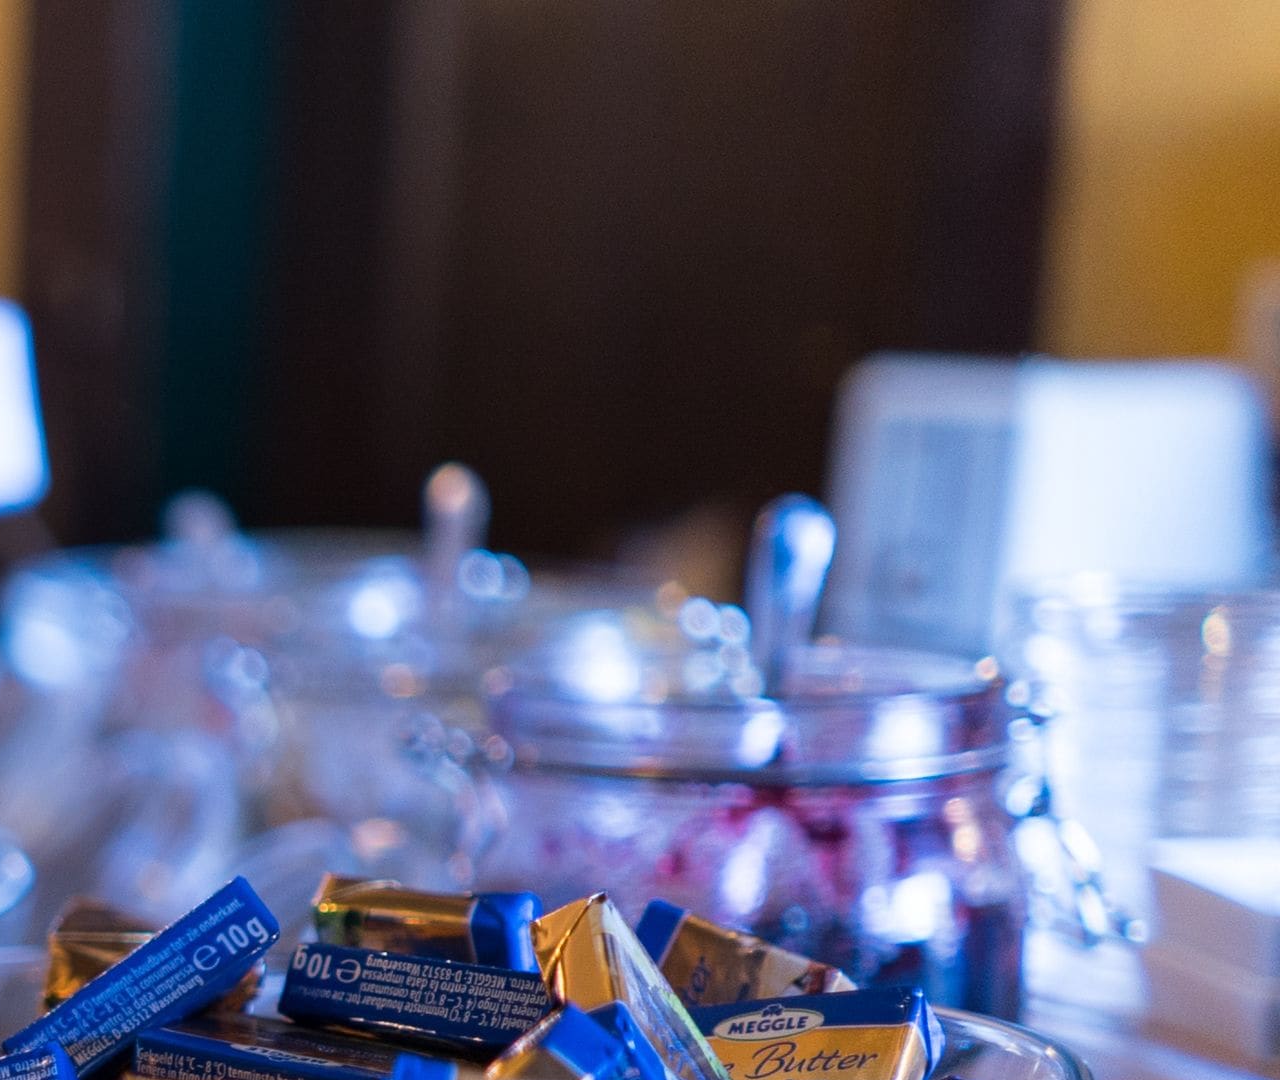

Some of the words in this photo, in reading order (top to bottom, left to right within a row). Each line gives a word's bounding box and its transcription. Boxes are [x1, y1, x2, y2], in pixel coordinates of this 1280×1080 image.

[363, 952, 420, 977] Wasserburg
[421, 963, 463, 983] D-83512
[147, 970, 206, 1018] Wasserburg
[405, 975, 428, 991] data
[438, 979, 467, 996] entro
[130, 987, 156, 1011] data
[728, 1016, 809, 1035] MEGGLE
[745, 1041, 878, 1079] Butter
